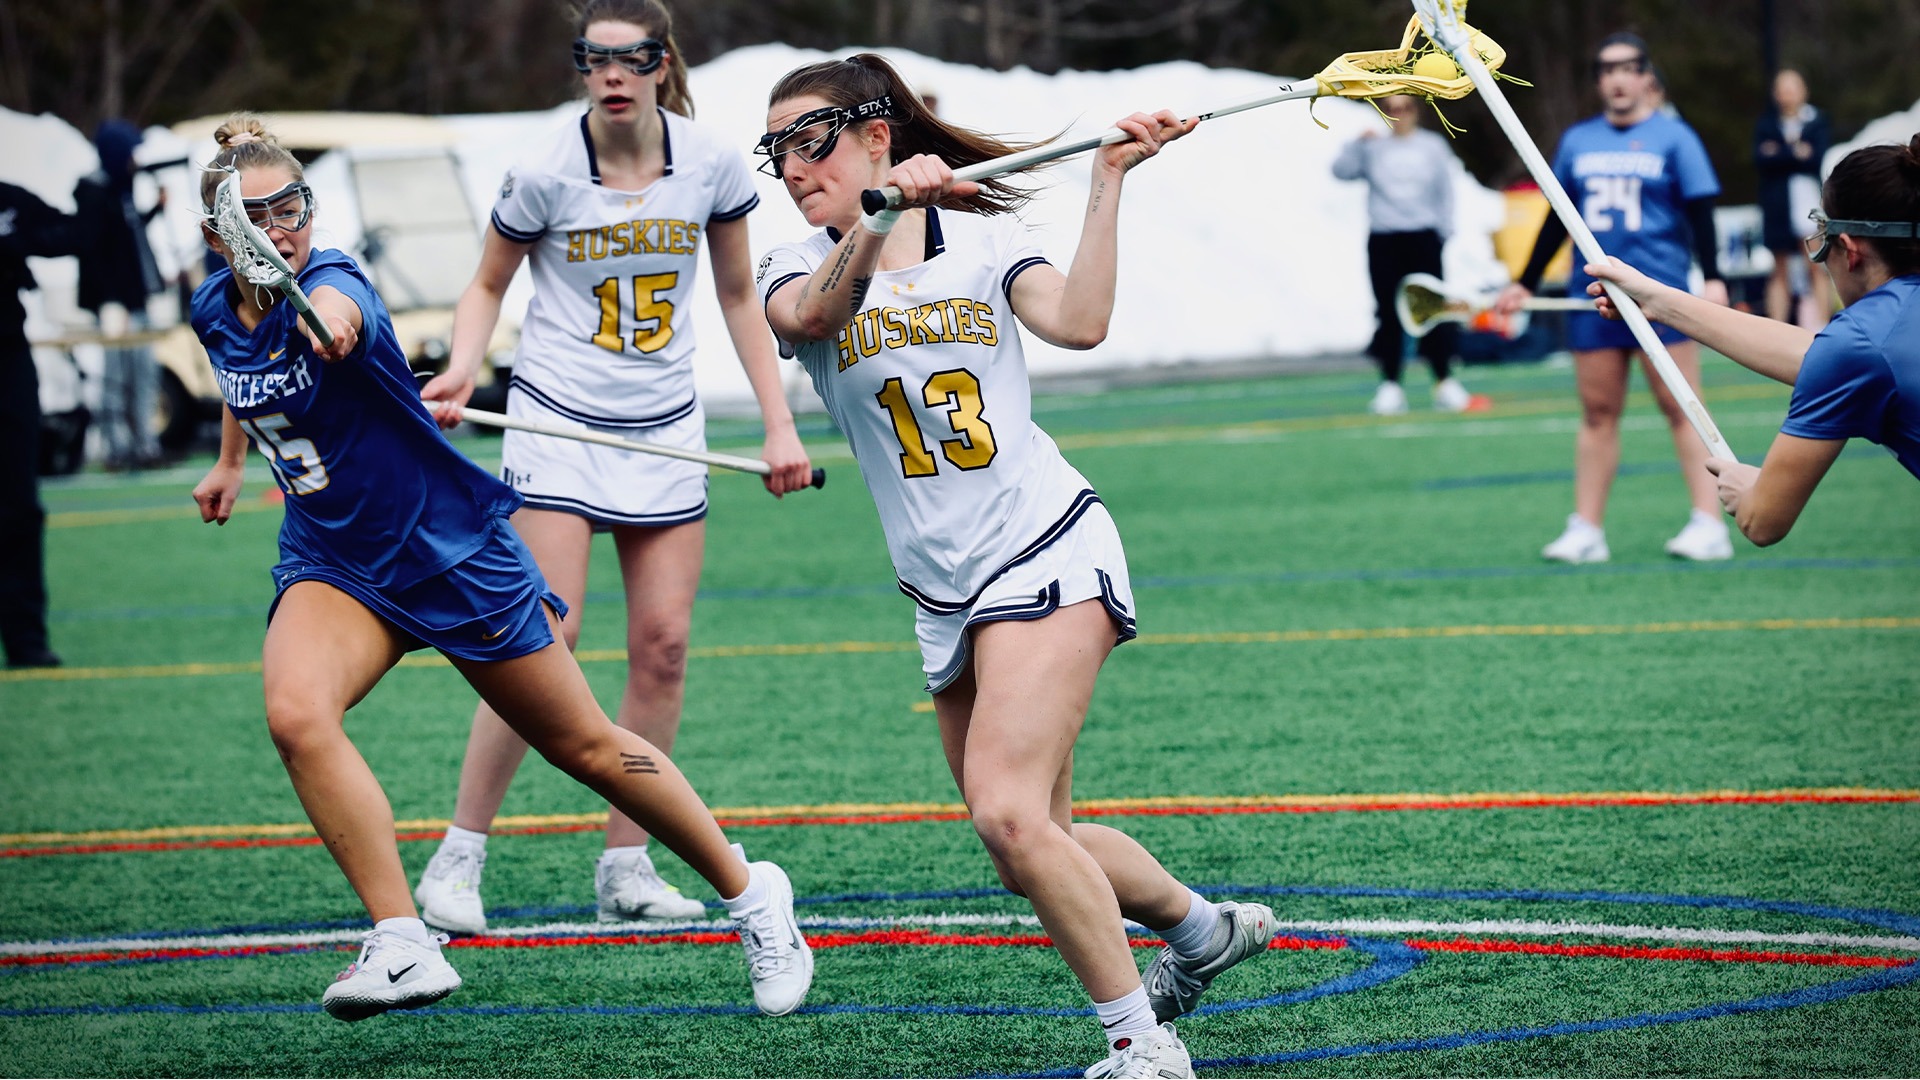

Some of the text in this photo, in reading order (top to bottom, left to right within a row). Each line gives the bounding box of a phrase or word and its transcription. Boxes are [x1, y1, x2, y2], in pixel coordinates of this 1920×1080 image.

[859, 99, 883, 116] STX
[567, 219, 699, 263] HUSKIES
[1584, 176, 1643, 233] 24
[592, 271, 679, 354] 15
[837, 298, 999, 374] HUSKIES
[239, 412, 330, 496] 15
[875, 367, 999, 479] 13
